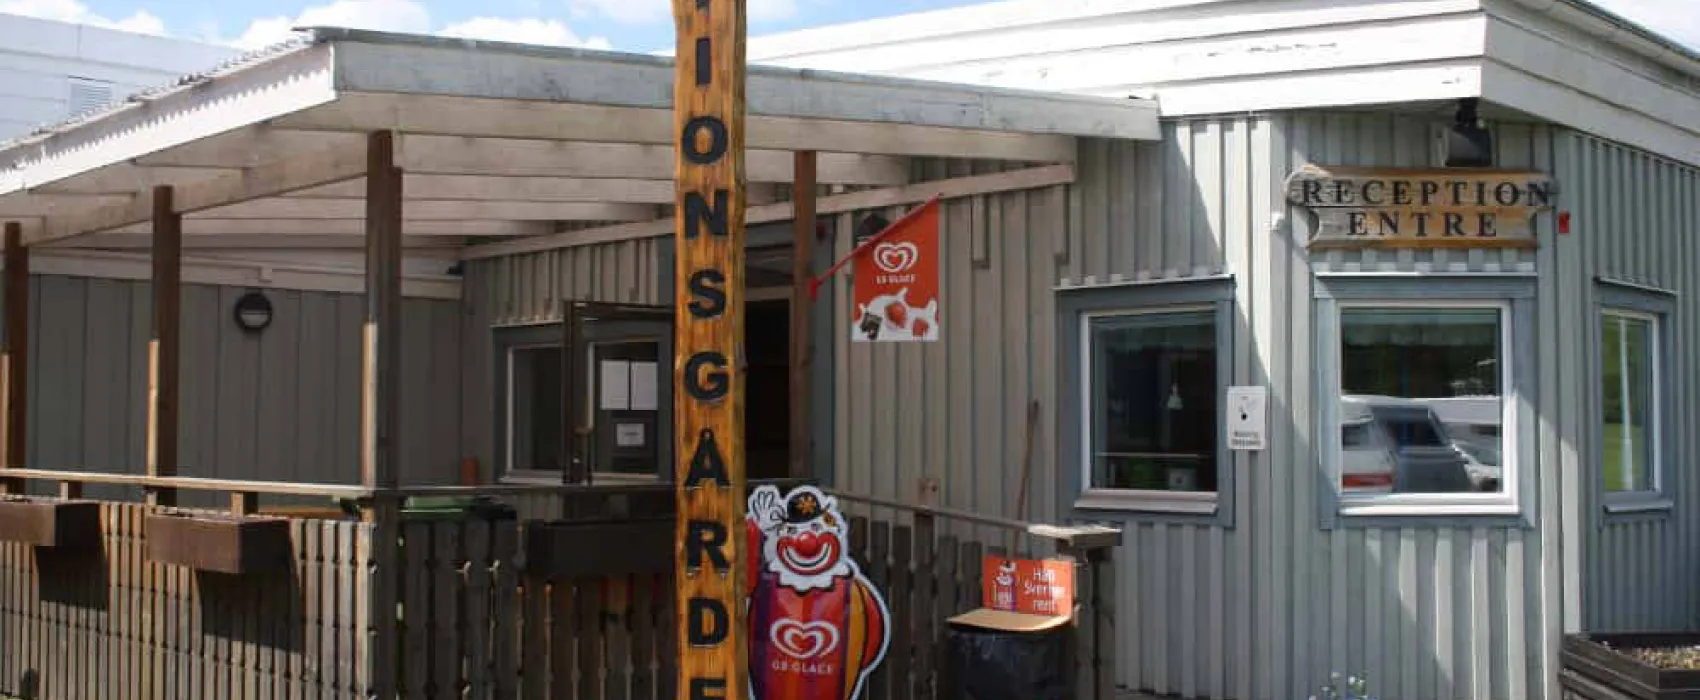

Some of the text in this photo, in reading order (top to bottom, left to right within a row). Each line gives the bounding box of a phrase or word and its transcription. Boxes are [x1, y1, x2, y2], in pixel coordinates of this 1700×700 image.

[1301, 179, 1551, 206] RECEPTION
[1346, 211, 1497, 237] ENTRE
[1023, 580, 1065, 600] Sver
